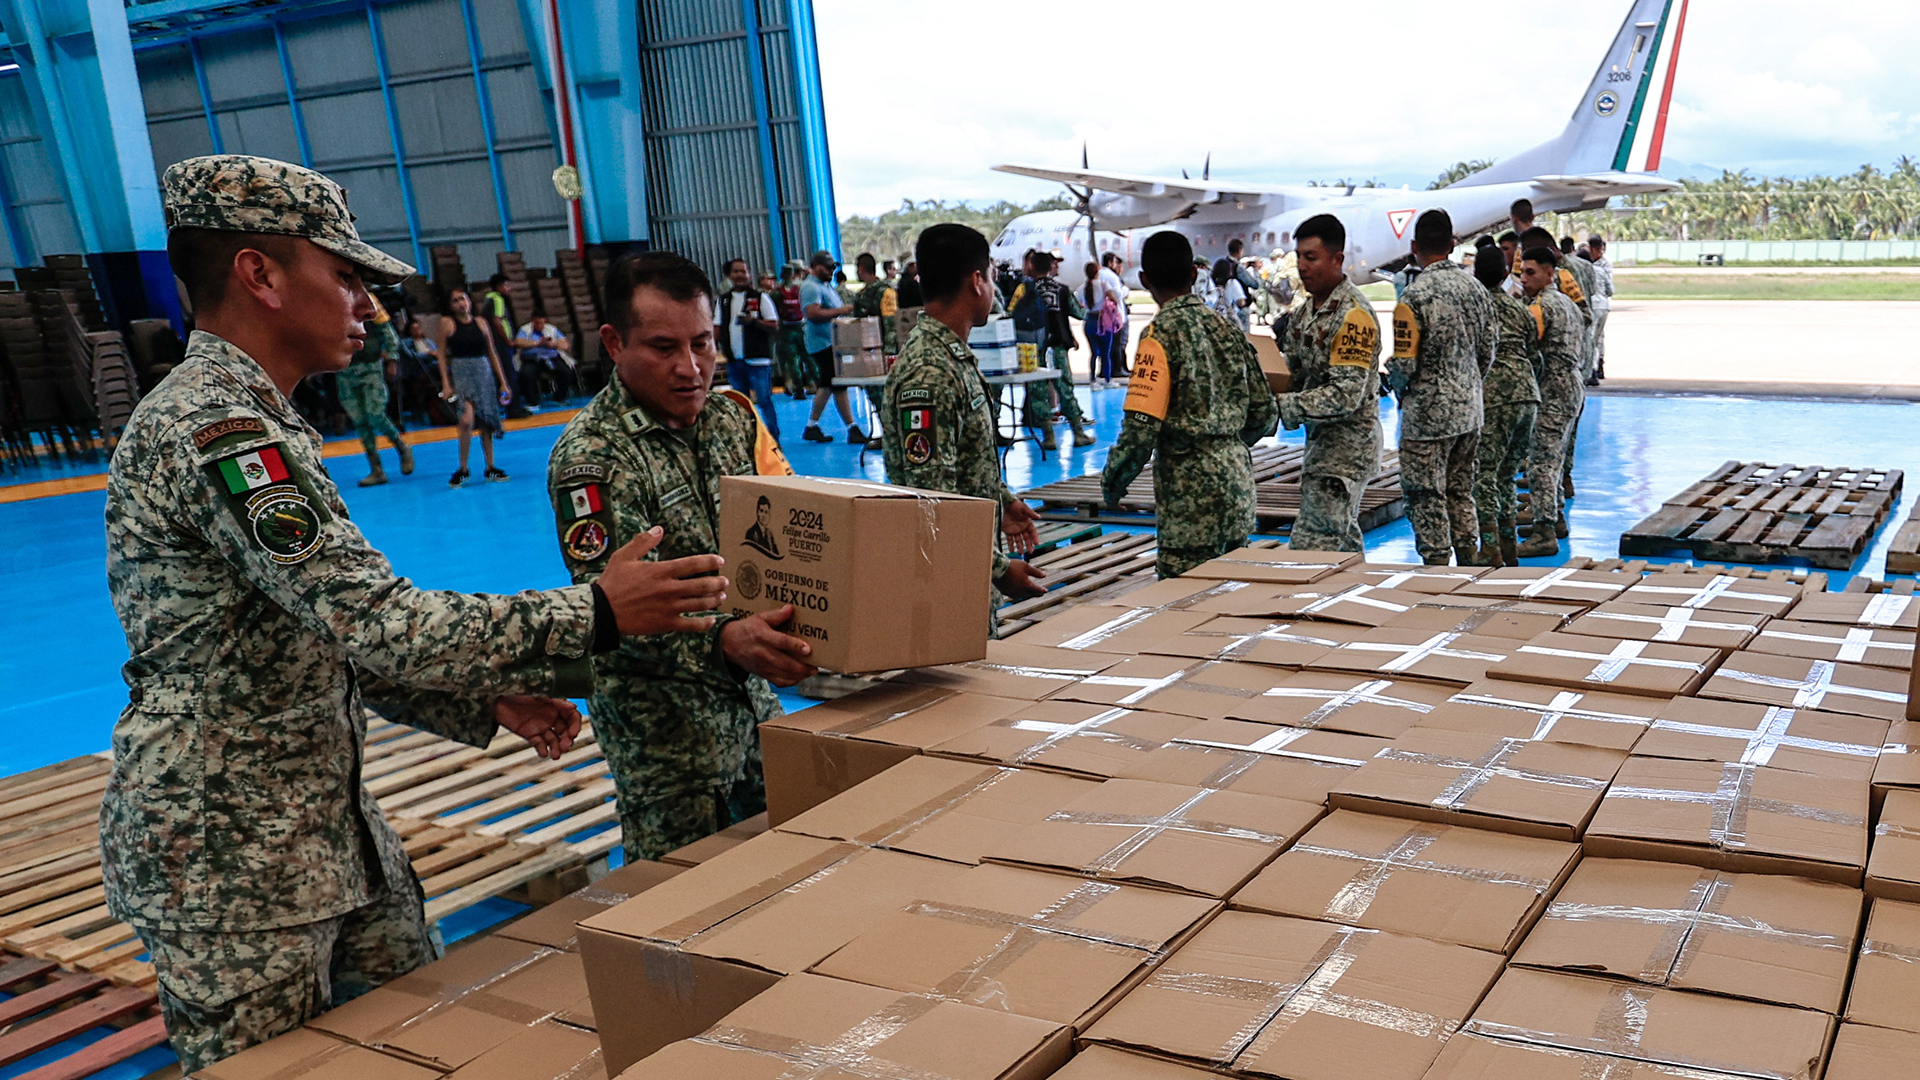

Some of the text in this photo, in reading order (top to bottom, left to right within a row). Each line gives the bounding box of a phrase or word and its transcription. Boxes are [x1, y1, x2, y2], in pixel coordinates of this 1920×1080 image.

[1607, 71, 1632, 83] 3206
[1020, 227, 1043, 236] FUERZA
[1347, 323, 1375, 339] PLAN
[1341, 335, 1374, 348] DN-III-
[1135, 353, 1155, 366] PLAN
[903, 390, 928, 398] MEXICO
[198, 419, 255, 442] MEXICO
[562, 465, 602, 477] MEXICO
[789, 508, 824, 530] 2024
[782, 525, 830, 543] Felipe Carrillo
[789, 538, 822, 552] PUERTO
[765, 568, 829, 592] GOBIERNO DE
[765, 583, 829, 612] MÉXICO
[798, 623, 829, 641] VENTA
